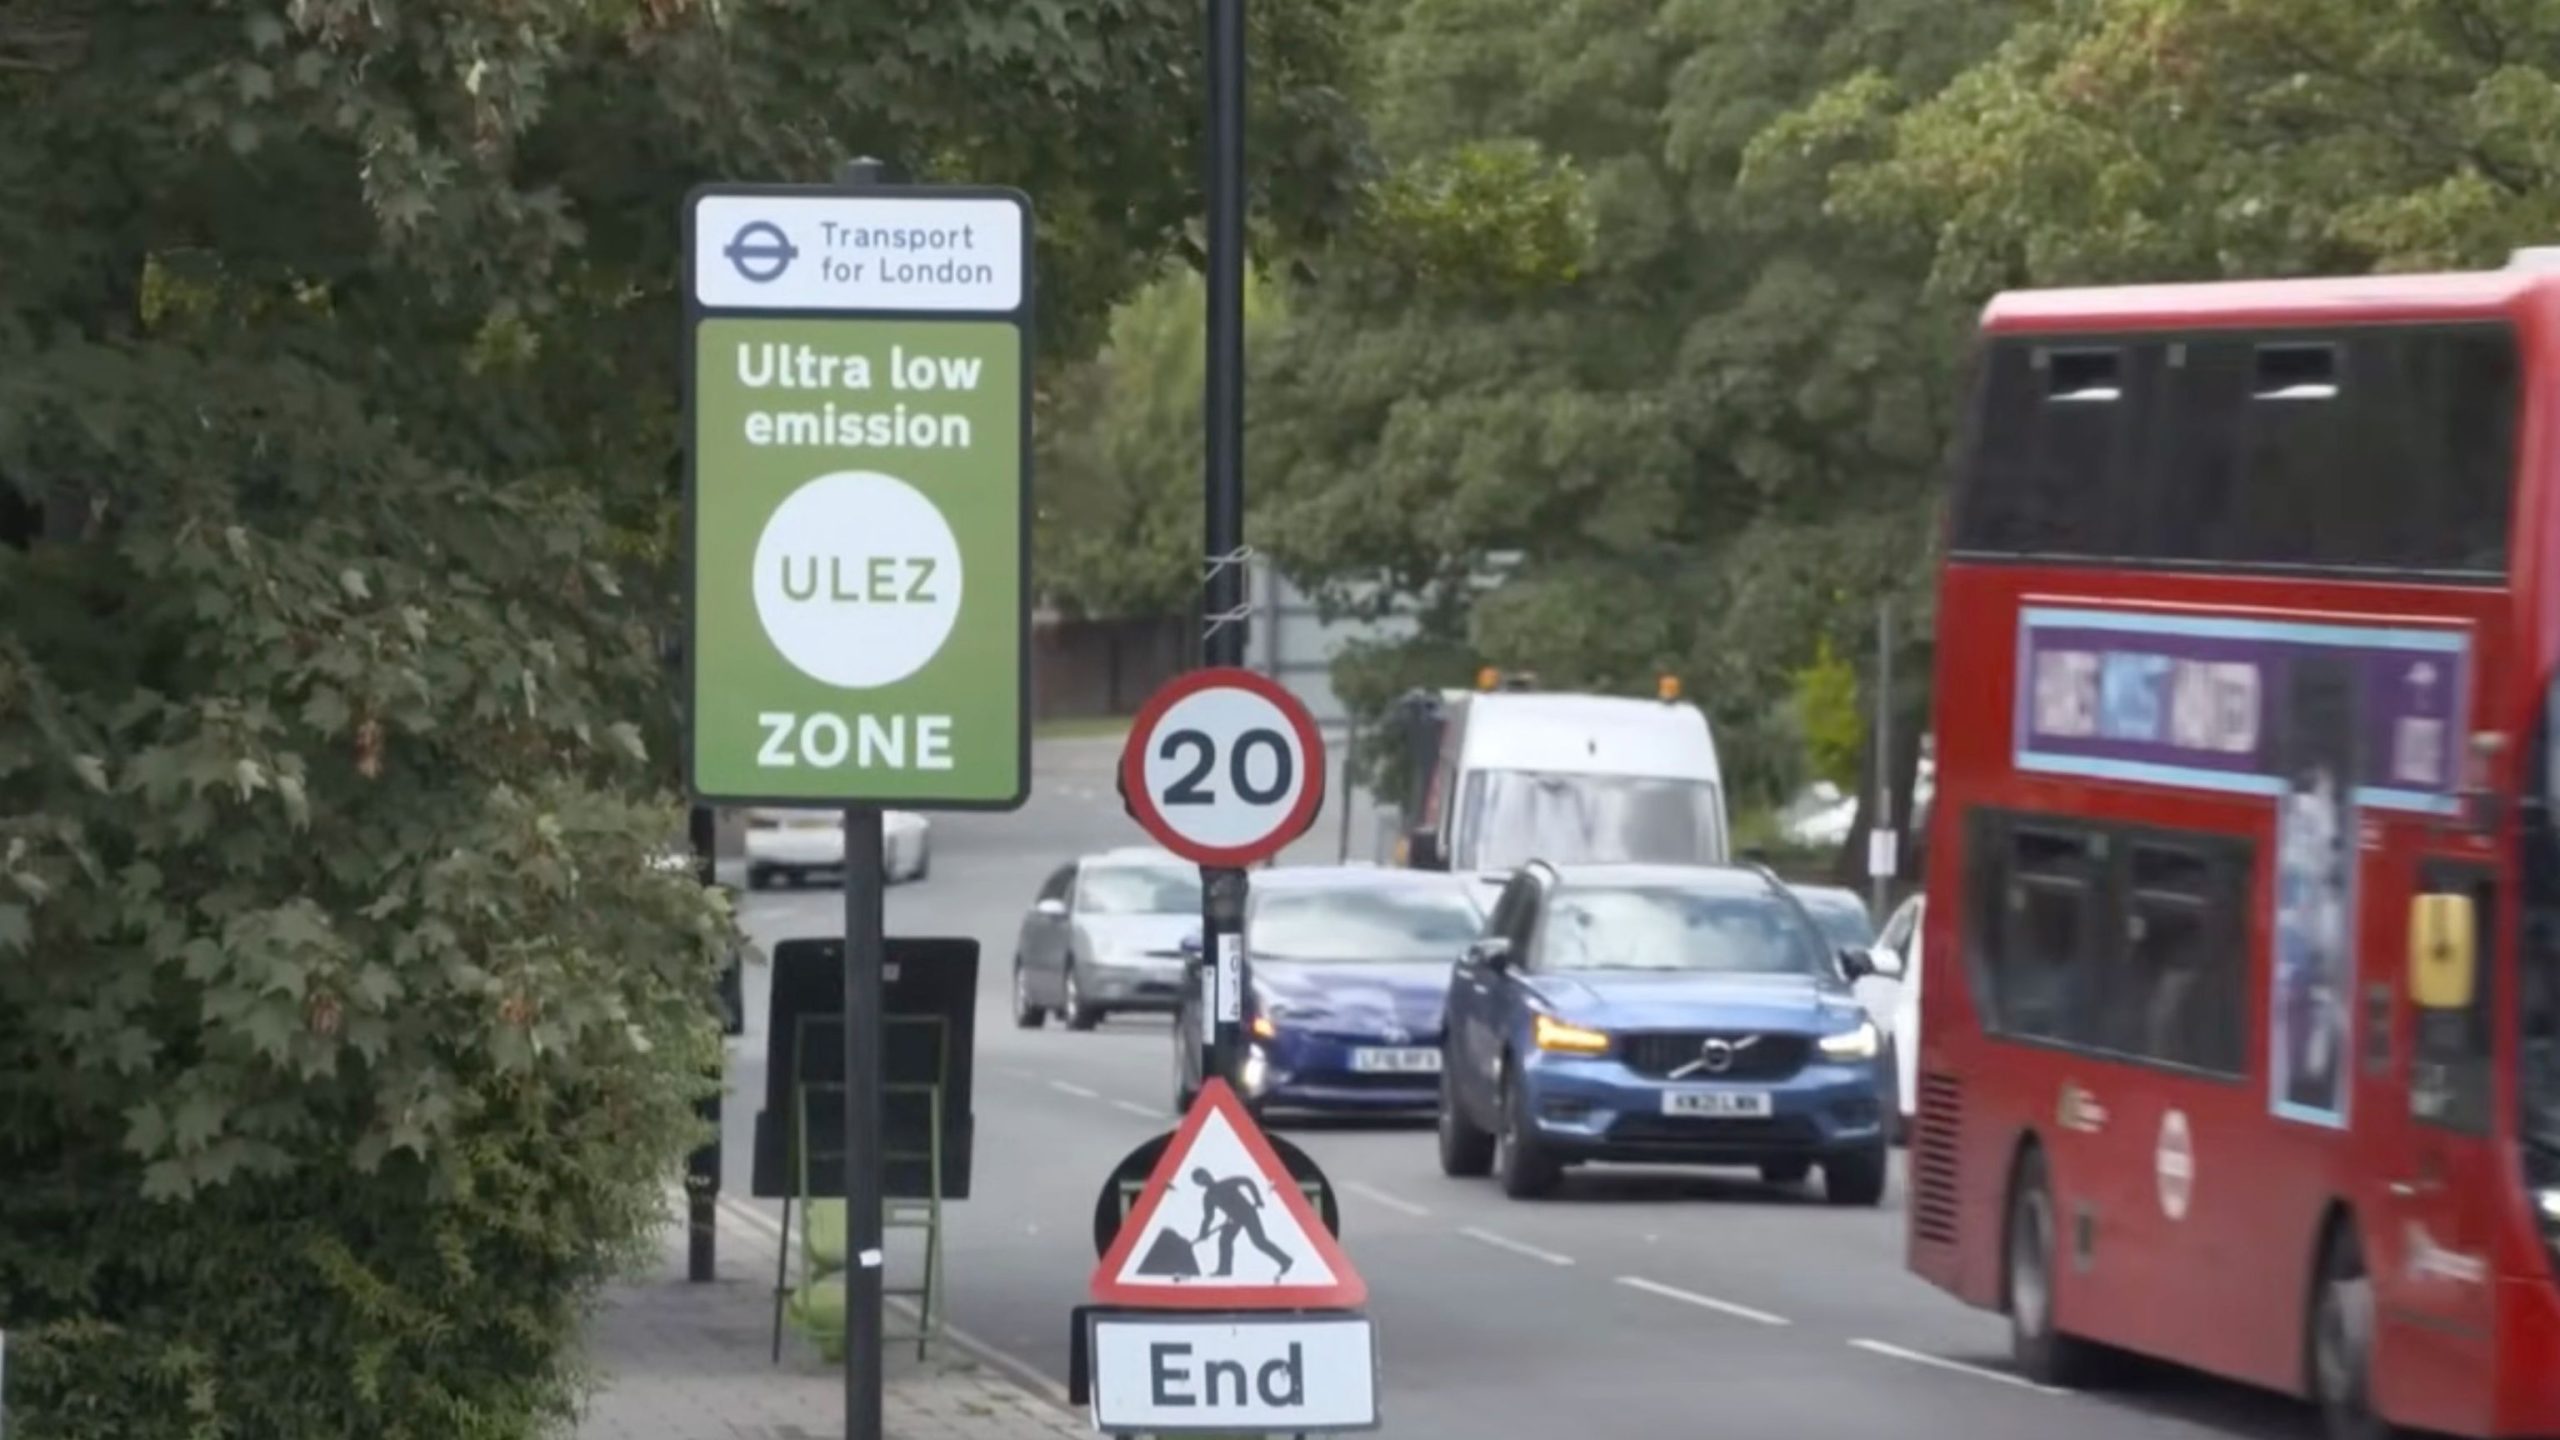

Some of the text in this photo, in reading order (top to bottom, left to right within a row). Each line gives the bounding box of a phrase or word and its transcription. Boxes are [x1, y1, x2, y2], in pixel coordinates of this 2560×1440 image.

[821, 221, 974, 252] Transport
[821, 257, 993, 284] for London
[737, 343, 983, 390] Ultra low
[744, 402, 971, 447] emission
[781, 555, 937, 602] ULEZ
[757, 711, 954, 770] ZONE
[1159, 728, 1293, 806] 20
[1150, 1341, 1305, 1408] End
